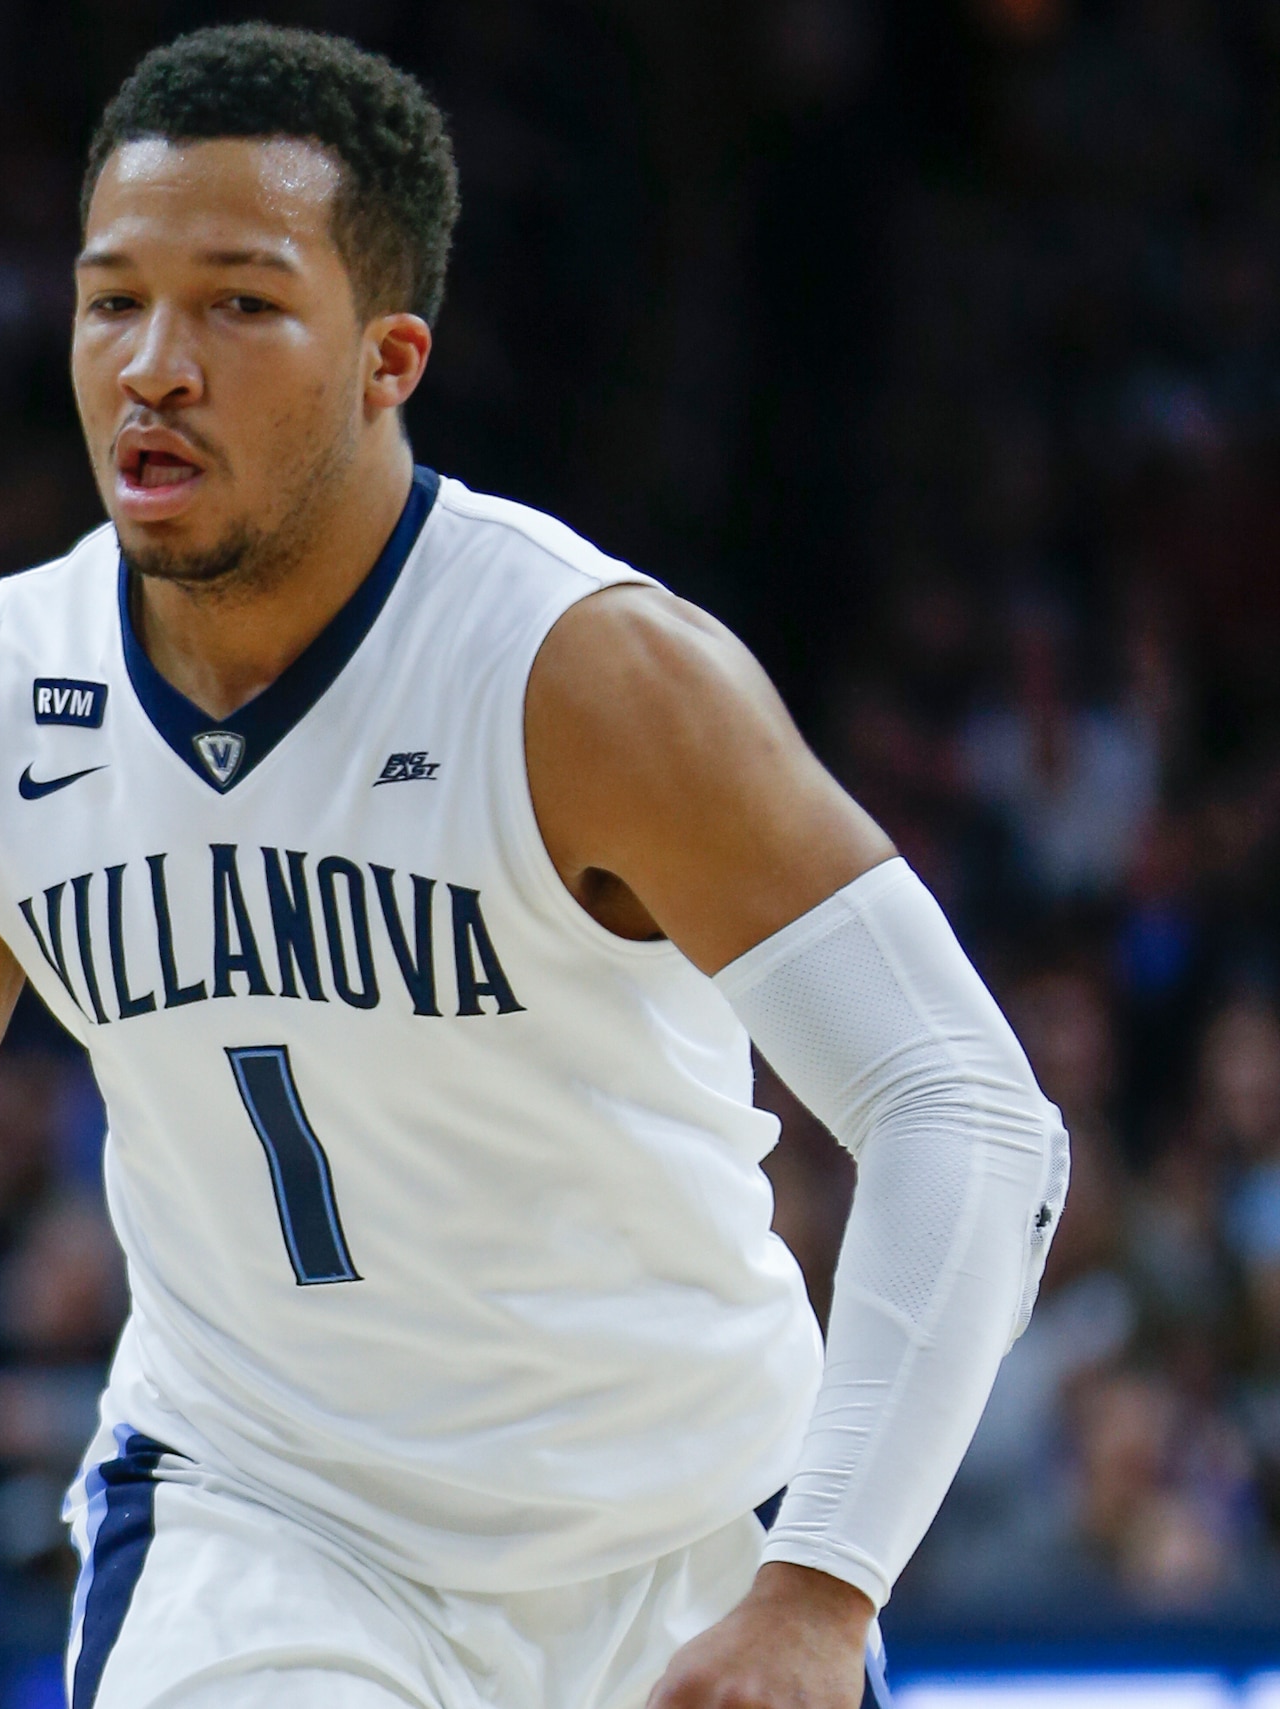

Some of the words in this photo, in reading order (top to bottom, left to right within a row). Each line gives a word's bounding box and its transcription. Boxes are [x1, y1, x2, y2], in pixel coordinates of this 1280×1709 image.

[38, 687, 94, 717] RVM
[209, 743, 232, 768] V
[386, 752, 429, 765] BIG
[379, 763, 441, 778] EAST
[18, 843, 528, 1025] VILLANOVA
[223, 1044, 365, 1286] 1
